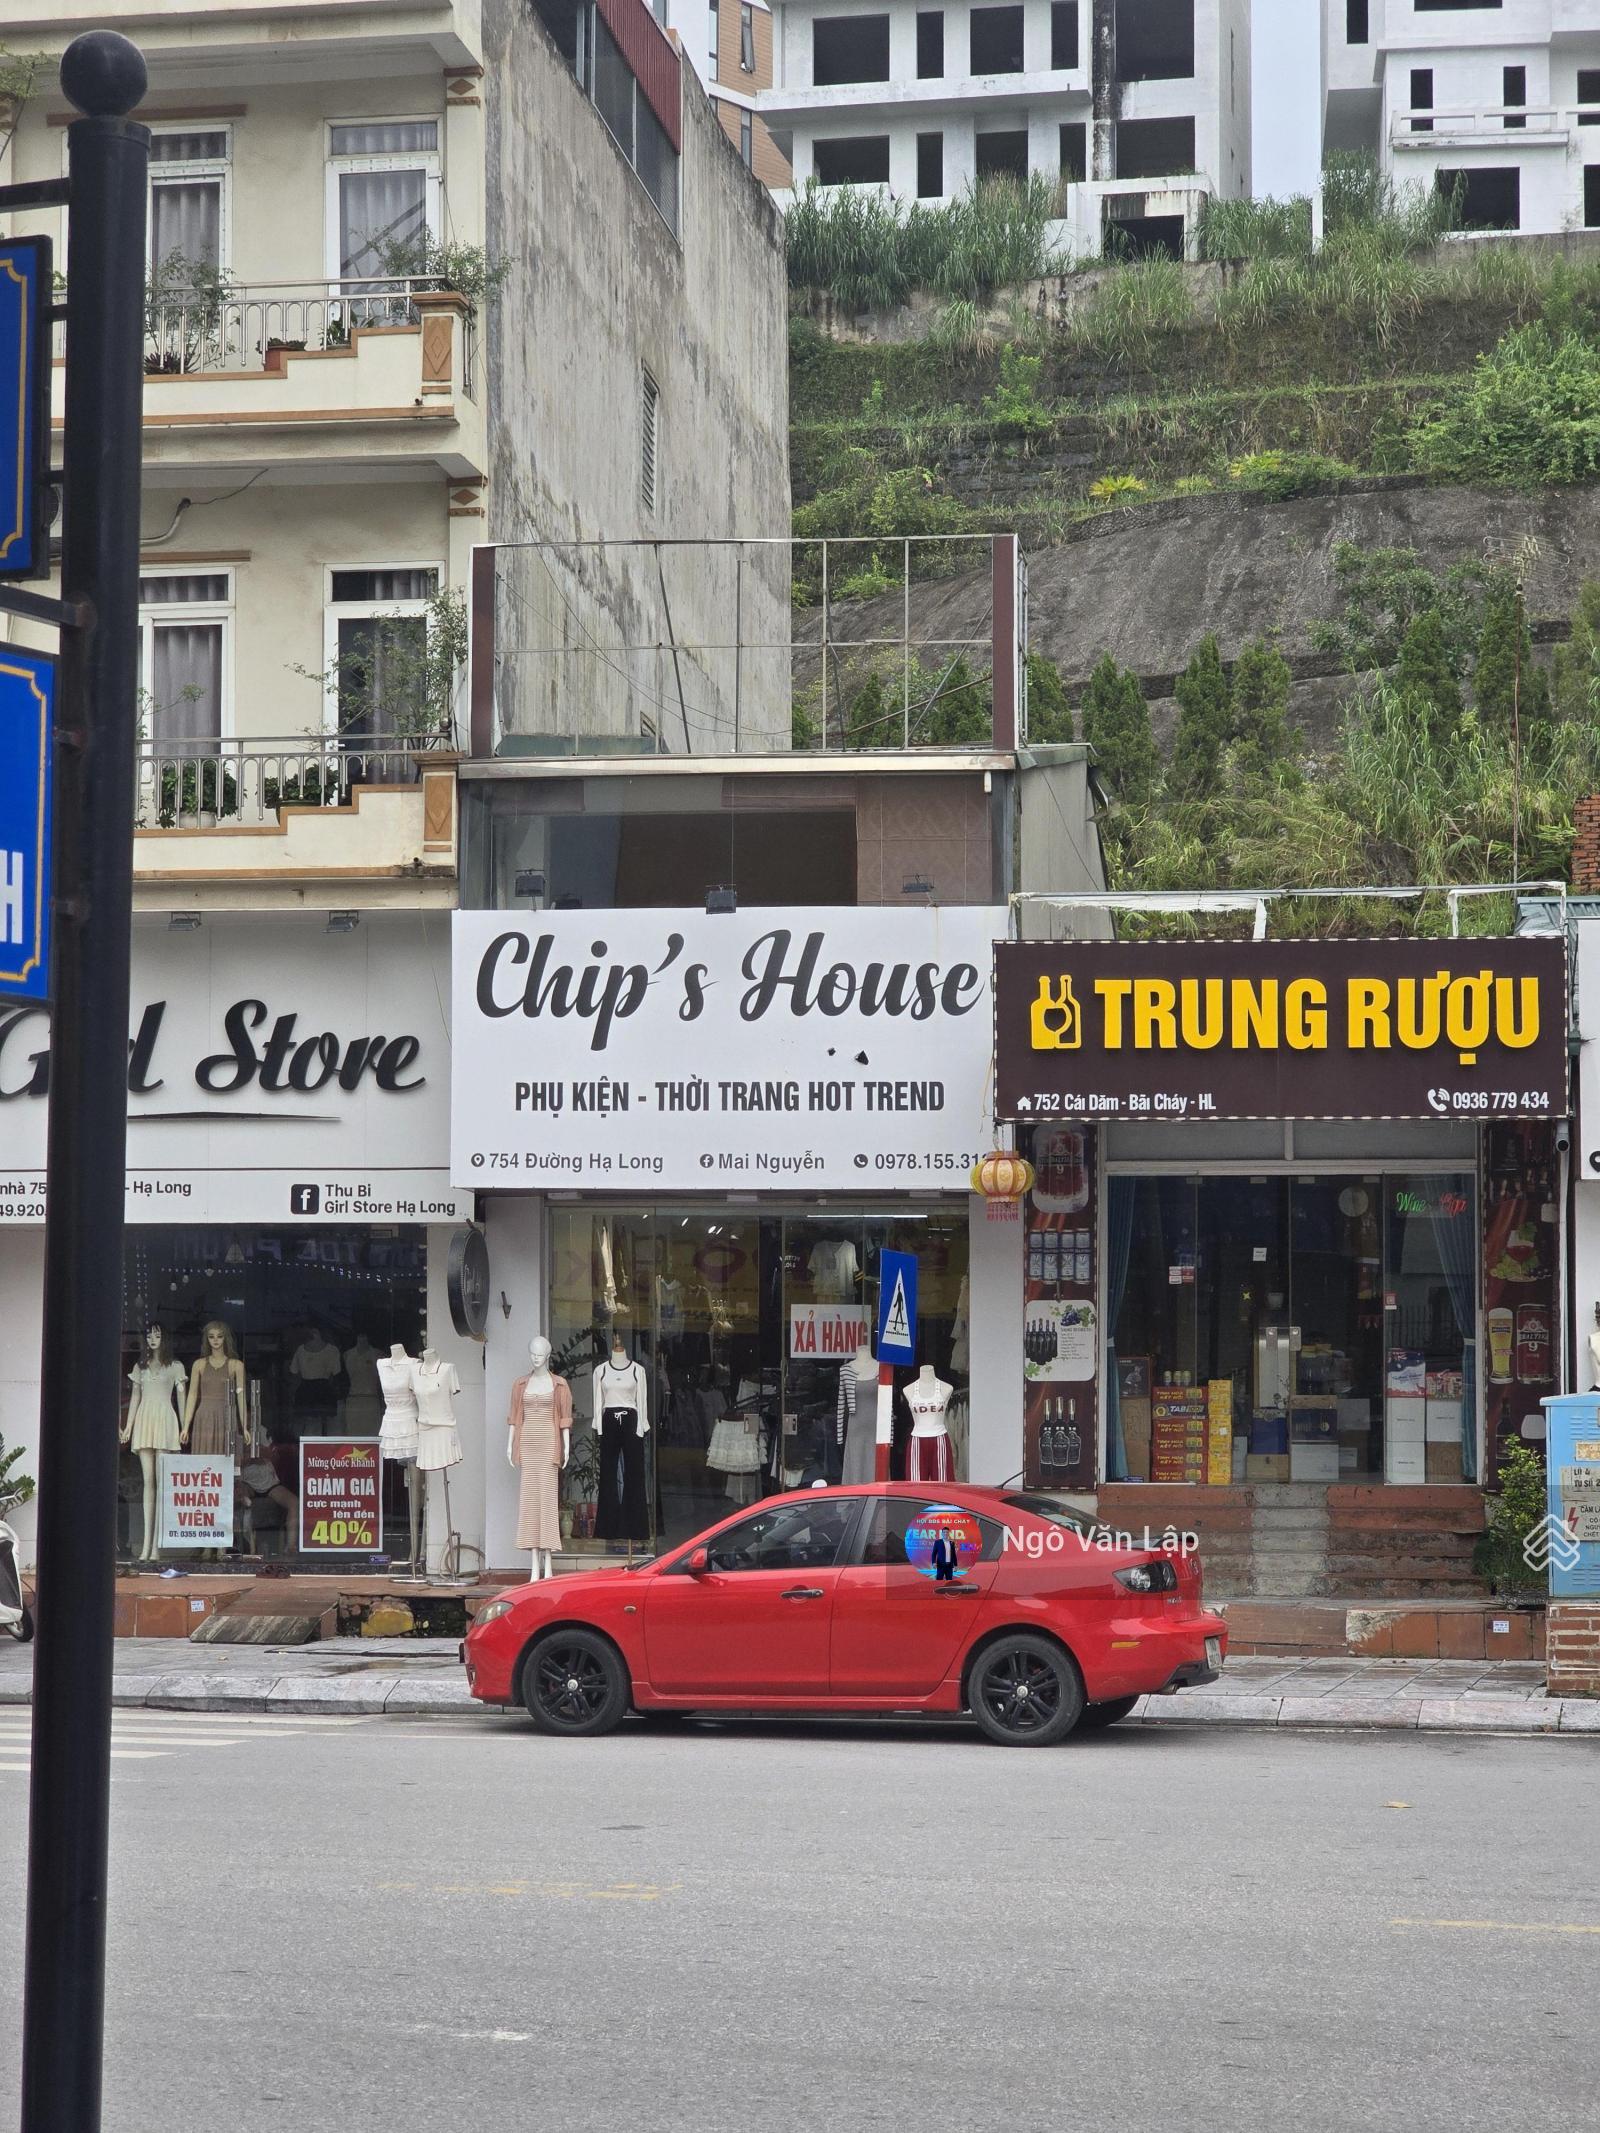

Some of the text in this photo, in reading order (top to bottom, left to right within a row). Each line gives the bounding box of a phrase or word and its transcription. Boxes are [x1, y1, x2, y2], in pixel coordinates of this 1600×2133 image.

[476, 928, 985, 1051] Chip's House
[1094, 970, 1540, 1065] TRUNG RƯỢU
[194, 999, 426, 1093] Store
[515, 1080, 563, 1119] PHỤ
[572, 1075, 630, 1119] KIỆN
[655, 1073, 709, 1112] THỜI
[718, 1080, 800, 1112] TRANG
[808, 1080, 855, 1112] HOT
[862, 1080, 945, 1112] TREND
[1034, 1093, 1060, 1110] 752
[1153, 1093, 1188, 1114] Cháy
[1198, 1093, 1216, 1110] HL
[1452, 1091, 1550, 1109] 0936 779 434
[489, 1151, 663, 1174] 754 Đường Hạ Long
[718, 1149, 825, 1174] Mai Nguyễn
[133, 1181, 152, 1197] Hạ
[156, 1181, 192, 1197] Long
[325, 1184, 372, 1197] Thu Bi
[325, 1200, 456, 1216] Girl Store Hạ Long
[794, 1309, 816, 1352] XẢ
[913, 1405, 944, 1414] IDEA
[308, 1456, 329, 1470] Mừng
[170, 1466, 222, 1488] TUYỂN
[307, 1474, 376, 1496] GIẢM GIÁ
[174, 1490, 220, 1506] NHÂN
[306, 1500, 362, 1510] cực mạnh
[178, 1510, 215, 1526] VIÊN
[332, 1510, 351, 1518] lên
[311, 1520, 372, 1545] 40%
